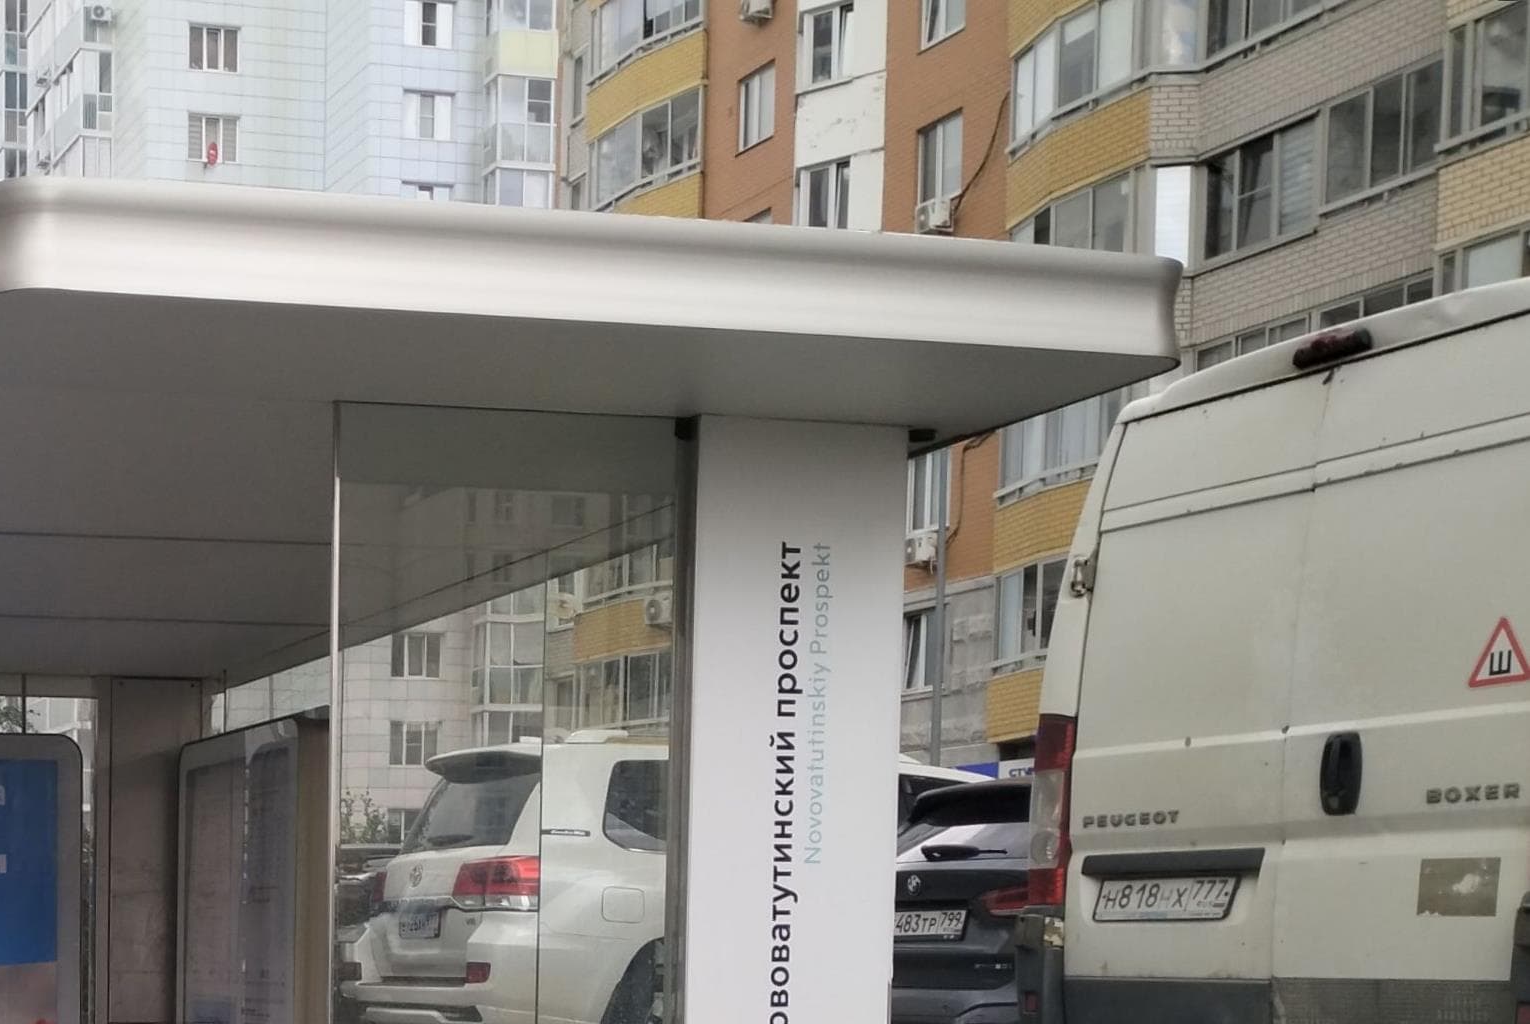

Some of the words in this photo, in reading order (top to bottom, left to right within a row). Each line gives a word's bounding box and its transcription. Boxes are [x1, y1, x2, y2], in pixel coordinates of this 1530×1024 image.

[810, 542, 834, 655] Prospekt
[776, 541, 803, 717] проспект
[1488, 649, 1512, 676] Ш
[804, 661, 832, 864] Novovatutinskiy
[1426, 783, 1521, 805] BOXER
[1082, 809, 1180, 829] PEUGEOT
[1192, 879, 1230, 901] 777
